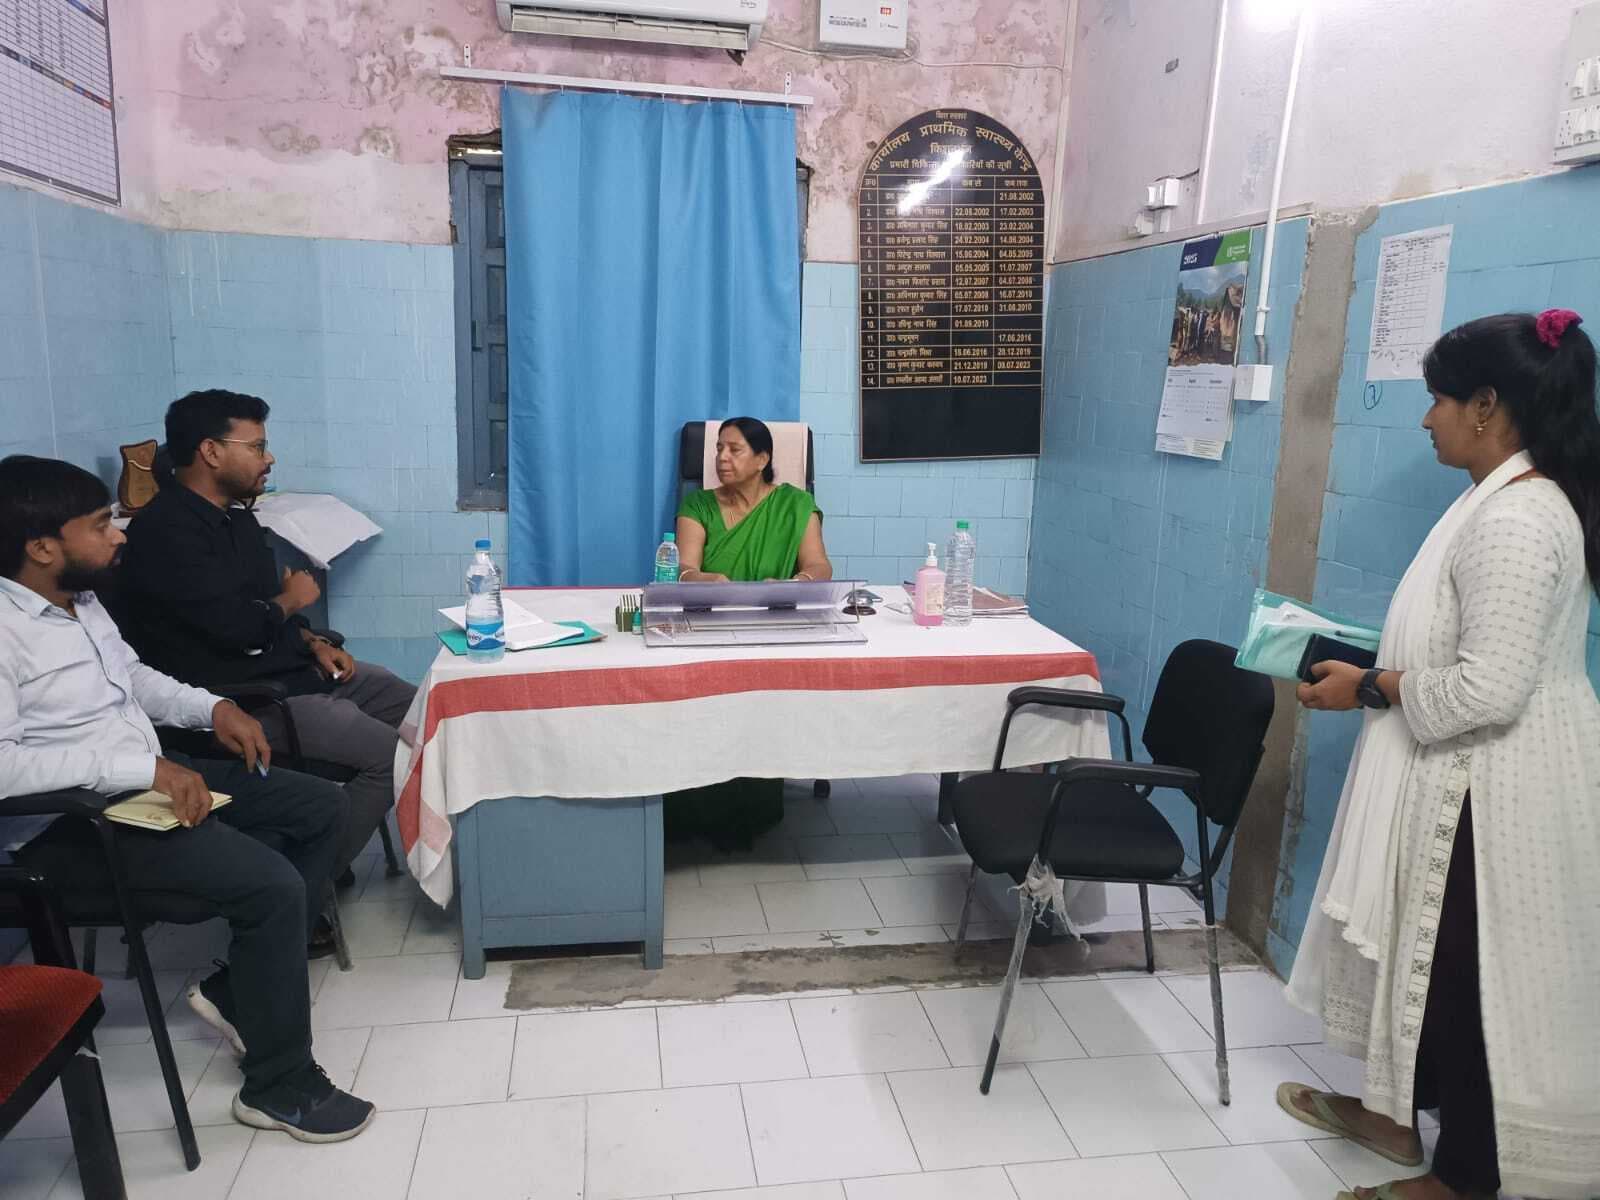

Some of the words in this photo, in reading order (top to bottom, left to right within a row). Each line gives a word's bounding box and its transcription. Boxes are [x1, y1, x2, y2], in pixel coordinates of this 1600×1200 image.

[870, 131, 912, 171] कार्यालय
[920, 122, 968, 137] प्राथमिक
[976, 126, 1014, 151] स्वास्थ्य
[890, 159, 908, 168] प्रभारी
[984, 159, 994, 168] की
[996, 159, 1012, 170] सूची
[1000, 192, 1034, 201] 21.08.2002
[955, 208, 990, 216] 22.08.2002
[1000, 208, 1034, 216] 17.02.2003
[1000, 222, 1034, 230] 23.02.2004
[955, 250, 989, 258] 15.06.2004
[1000, 263, 1032, 272] 11.07.2007
[955, 277, 989, 286] 12.07.2007
[955, 304, 989, 313] 17.07.2010
[954, 361, 987, 370] 21.12.2019
[953, 375, 987, 384] 10.07.2023
